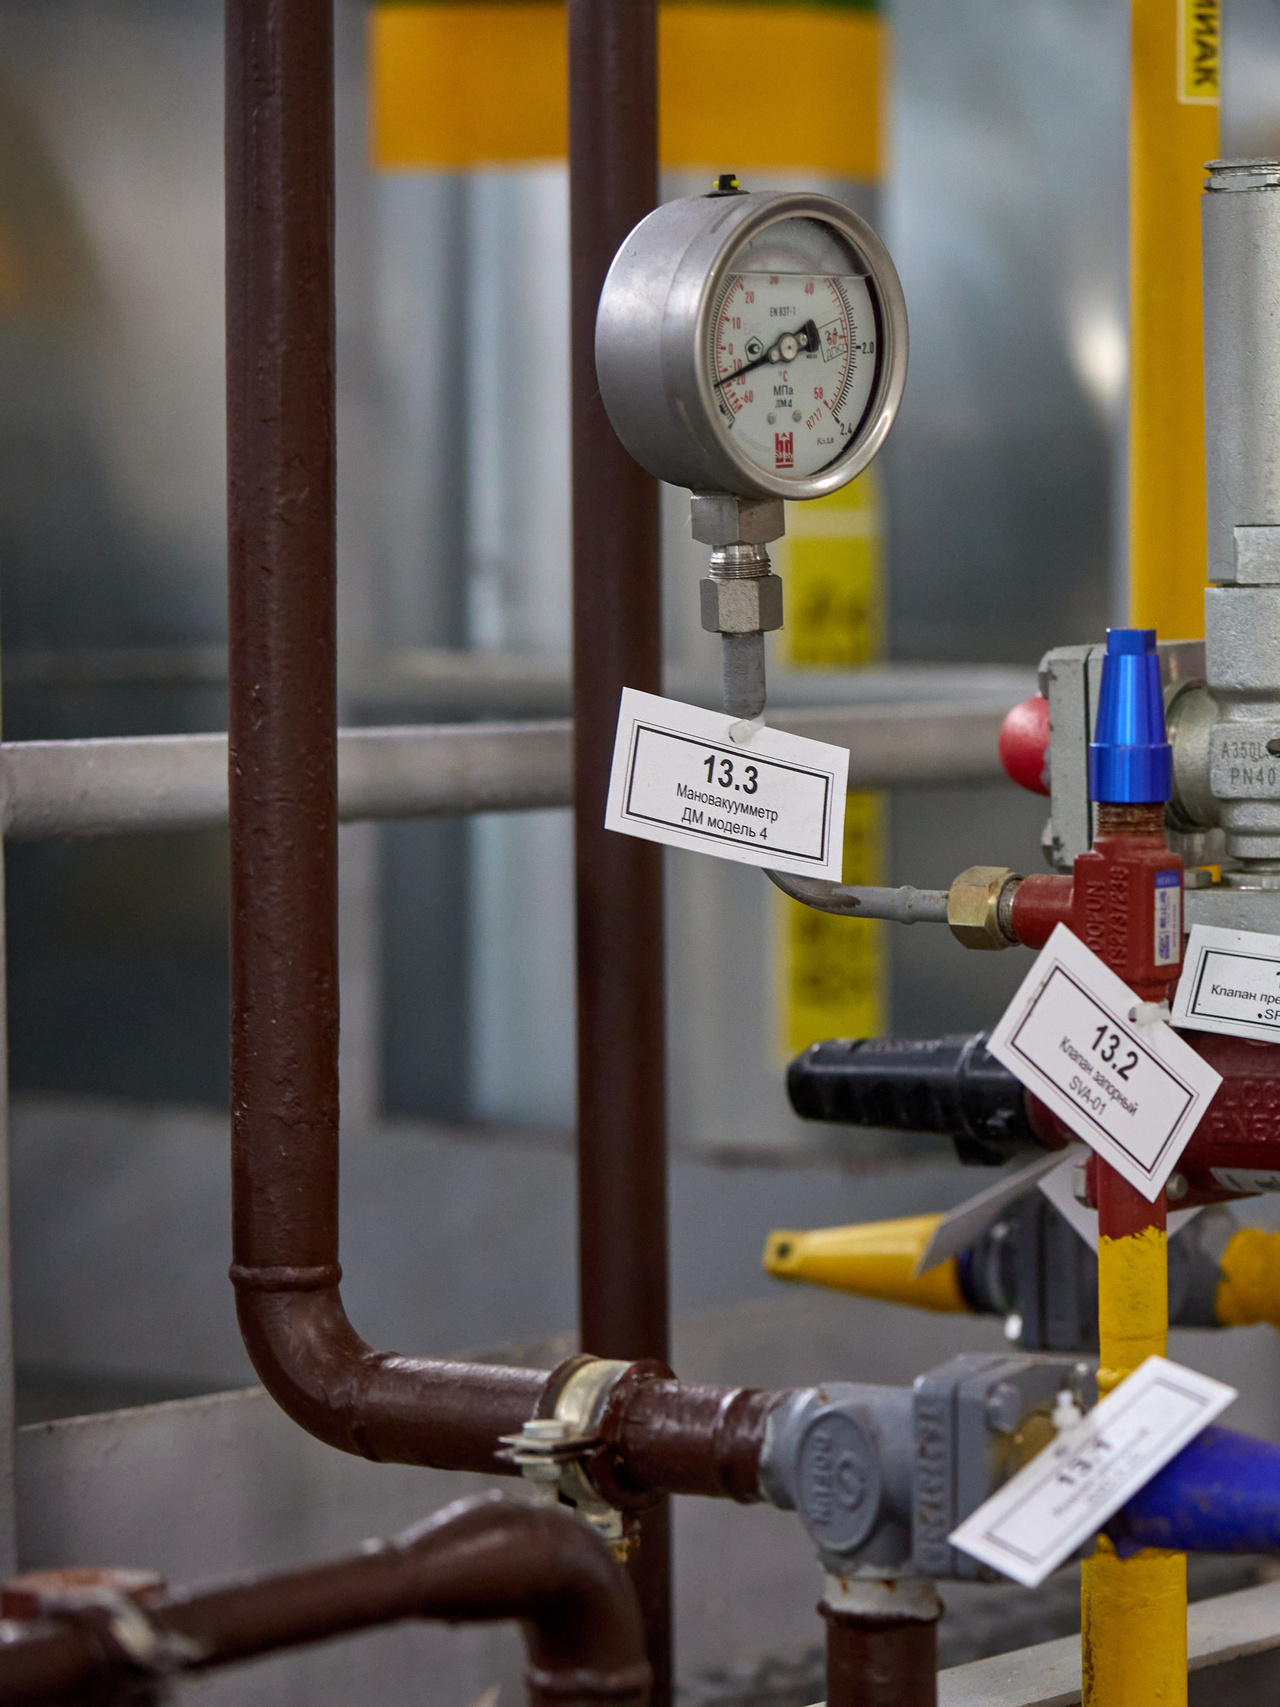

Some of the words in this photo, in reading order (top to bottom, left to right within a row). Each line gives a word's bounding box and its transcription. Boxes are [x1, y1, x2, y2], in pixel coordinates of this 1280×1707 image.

[804, 282, 815, 295] 40
[744, 291, 755, 304] 20
[769, 307, 778, 317] EN
[732, 317, 742, 330] 10
[728, 342, 734, 356] 0
[861, 341, 875, 355] 2.0
[740, 390, 754, 404] -60
[773, 384, 794, 396] МПа
[813, 387, 824, 400] 58
[805, 407, 823, 430] R717
[704, 755, 759, 795] 13.3
[1230, 767, 1276, 786] PN40
[676, 783, 779, 823] Мановакуумметр
[681, 807, 704, 825] ДМ
[707, 814, 756, 838] модель
[759, 827, 769, 840] 4
[1211, 984, 1257, 1002] Клапан
[1091, 1025, 1139, 1081] 13.2
[1059, 1036, 1093, 1075] Клапан
[1092, 1069, 1138, 1116] запорный
[1069, 1075, 1106, 1116] SVA-01
